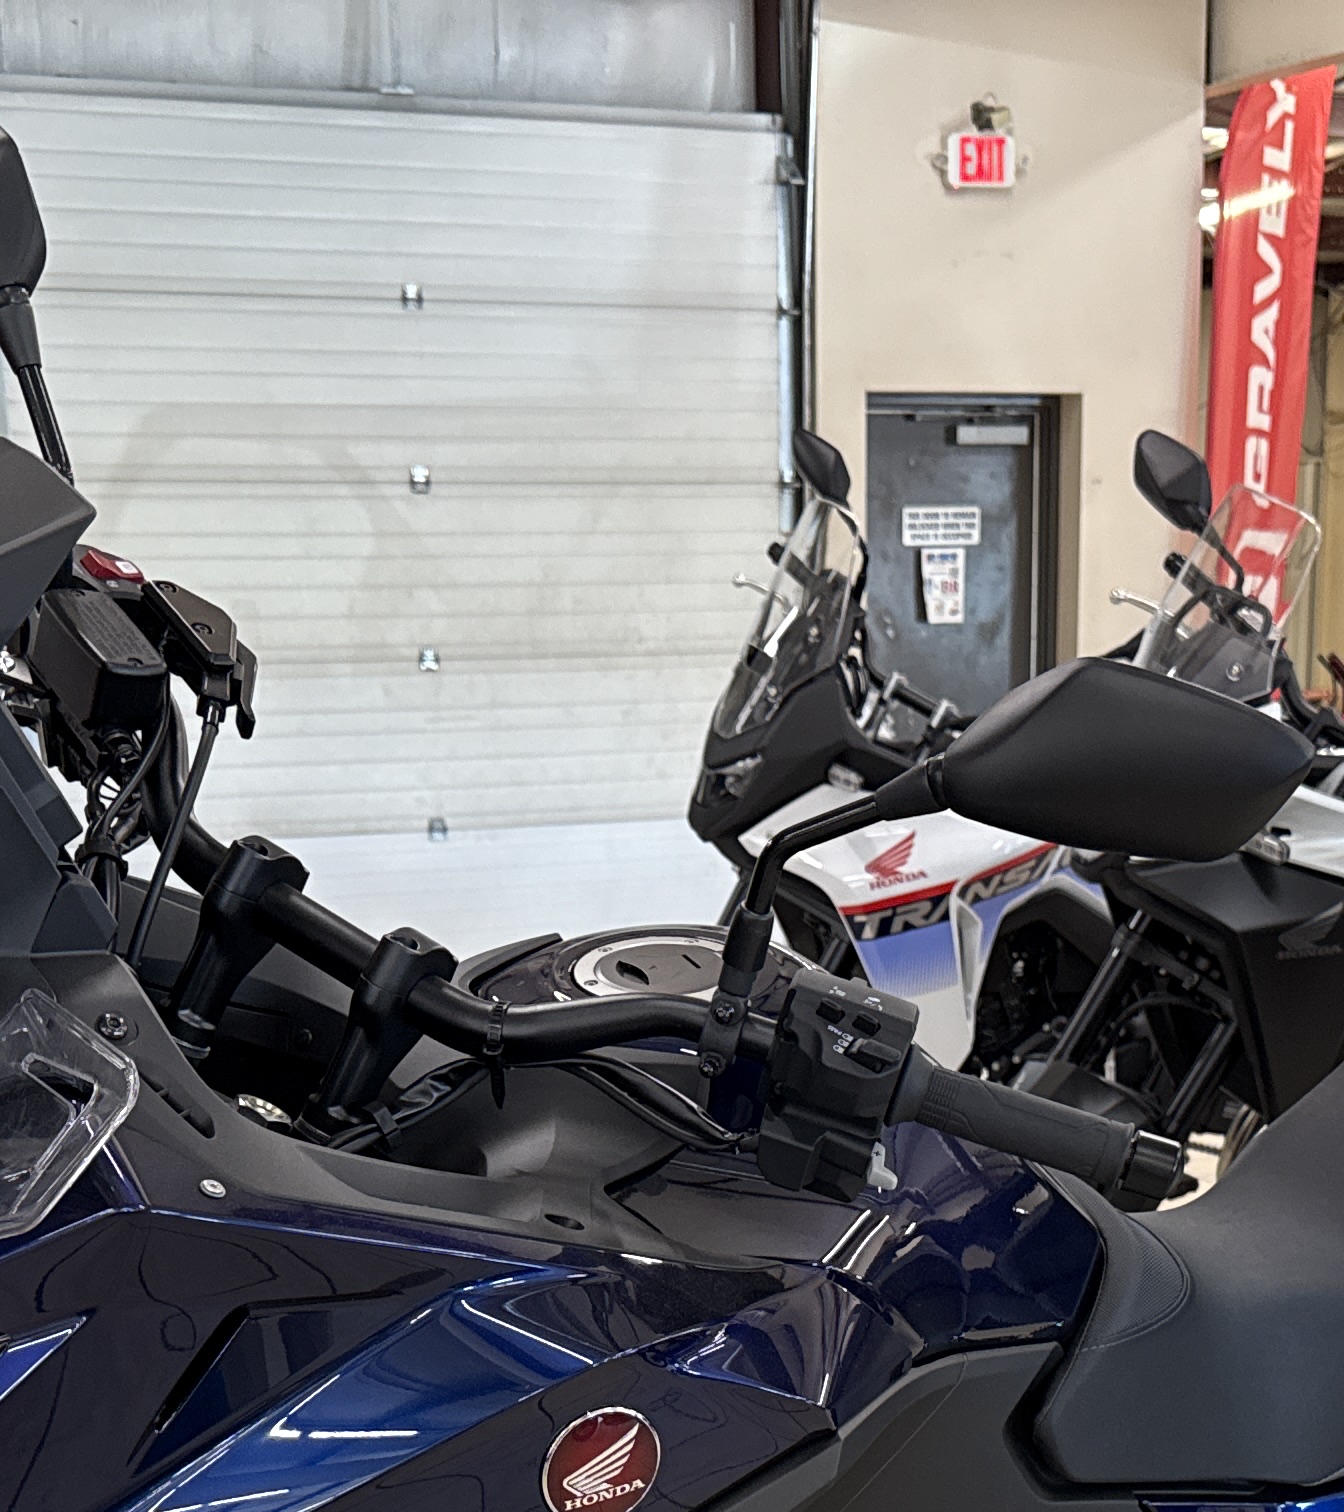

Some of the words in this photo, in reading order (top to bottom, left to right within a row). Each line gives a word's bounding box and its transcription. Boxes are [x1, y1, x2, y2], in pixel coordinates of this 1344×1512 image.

[959, 136, 1006, 183] EXIT
[1244, 78, 1297, 509] GRAVELY
[869, 869, 928, 892] HONDA
[563, 1478, 646, 1512] HONDA
